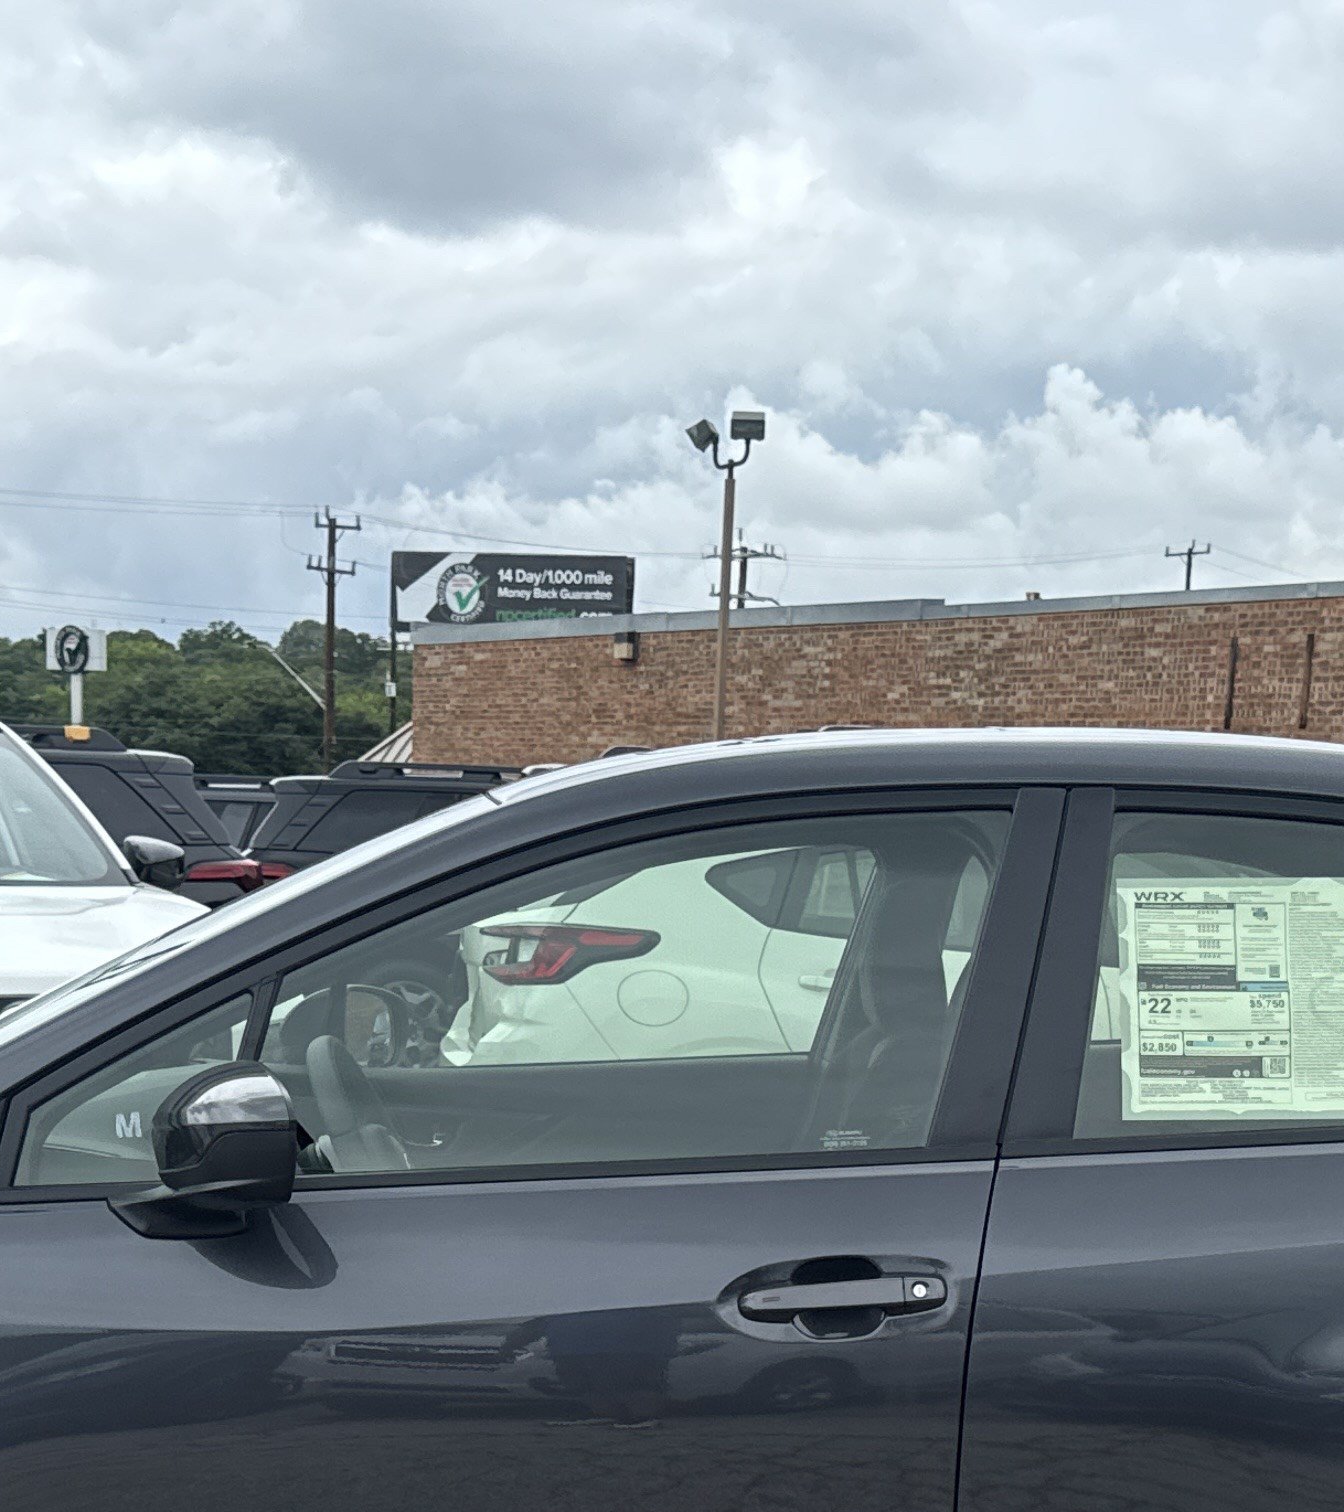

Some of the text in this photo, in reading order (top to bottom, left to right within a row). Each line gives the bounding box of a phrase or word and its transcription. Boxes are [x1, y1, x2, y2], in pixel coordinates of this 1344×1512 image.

[497, 568, 513, 583] 14
[584, 570, 614, 585] mile
[497, 587, 613, 601] Money Back Guarantee
[1134, 891, 1185, 901] WRX
[1148, 998, 1172, 1014] 22
[1142, 1042, 1177, 1053] $2,850
[115, 1111, 142, 1138] M
